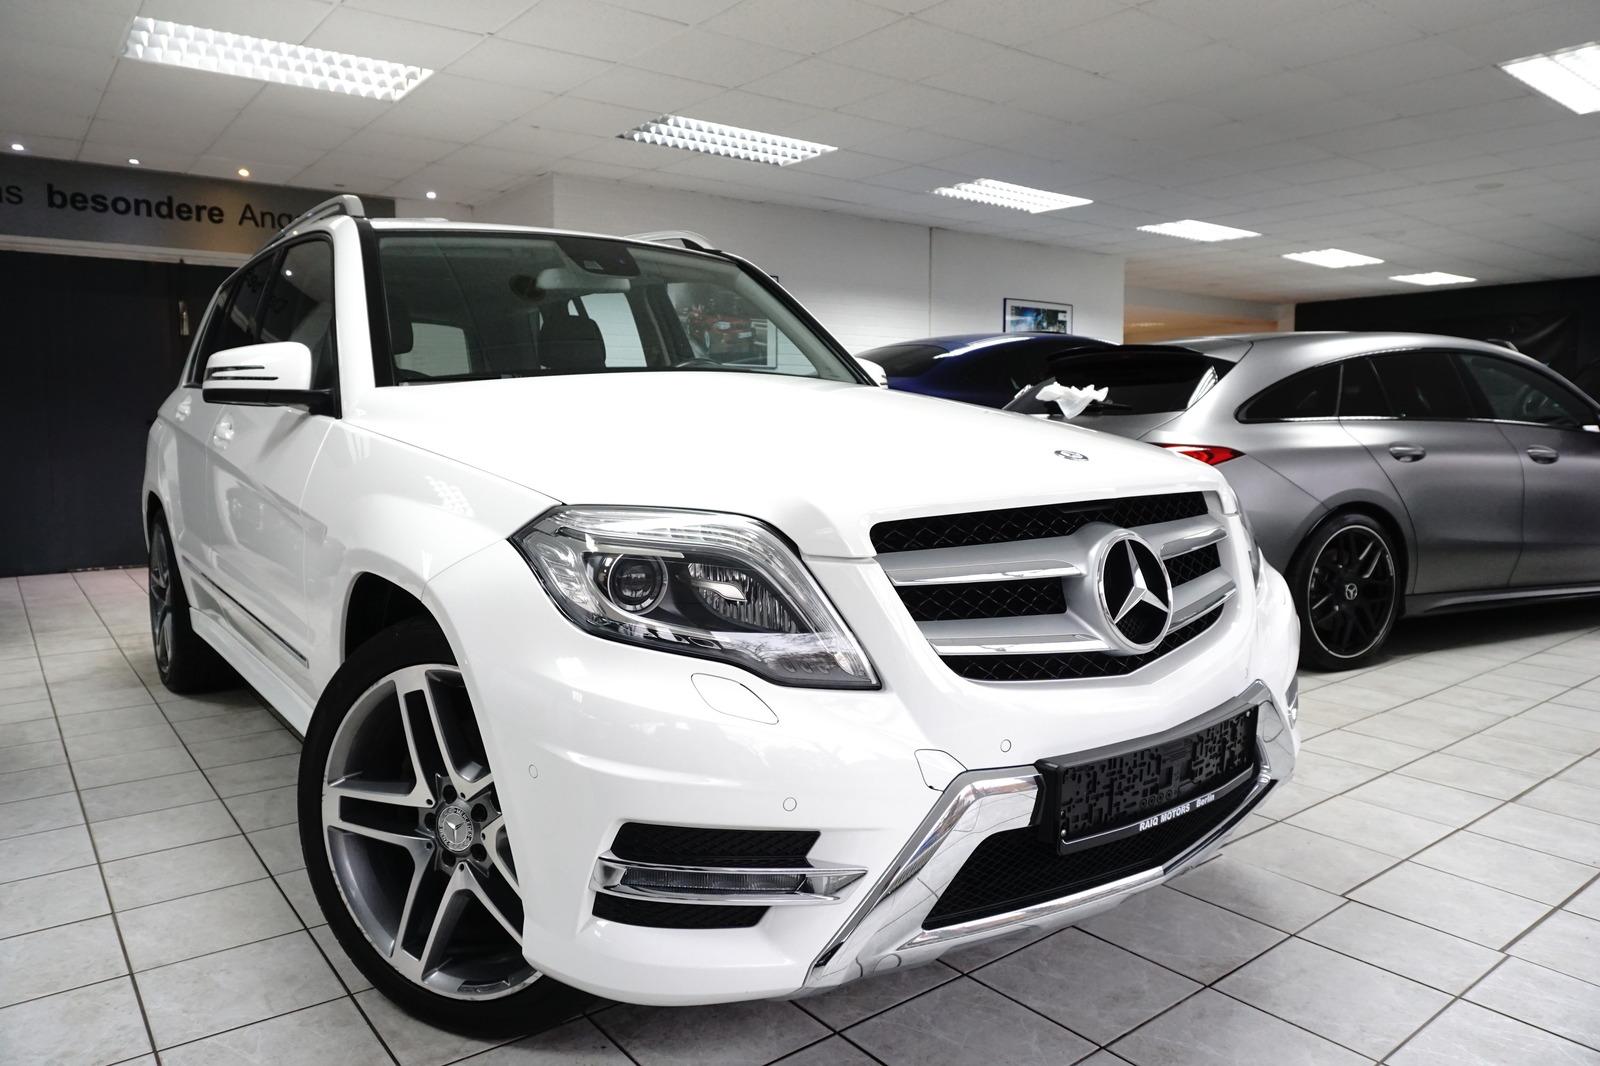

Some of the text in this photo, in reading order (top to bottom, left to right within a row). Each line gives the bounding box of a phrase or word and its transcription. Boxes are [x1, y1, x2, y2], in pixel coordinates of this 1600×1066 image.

[0, 185, 23, 205] s
[46, 183, 225, 224] besondere
[1139, 793, 1215, 832] RAIQ MOTORS Berlin
